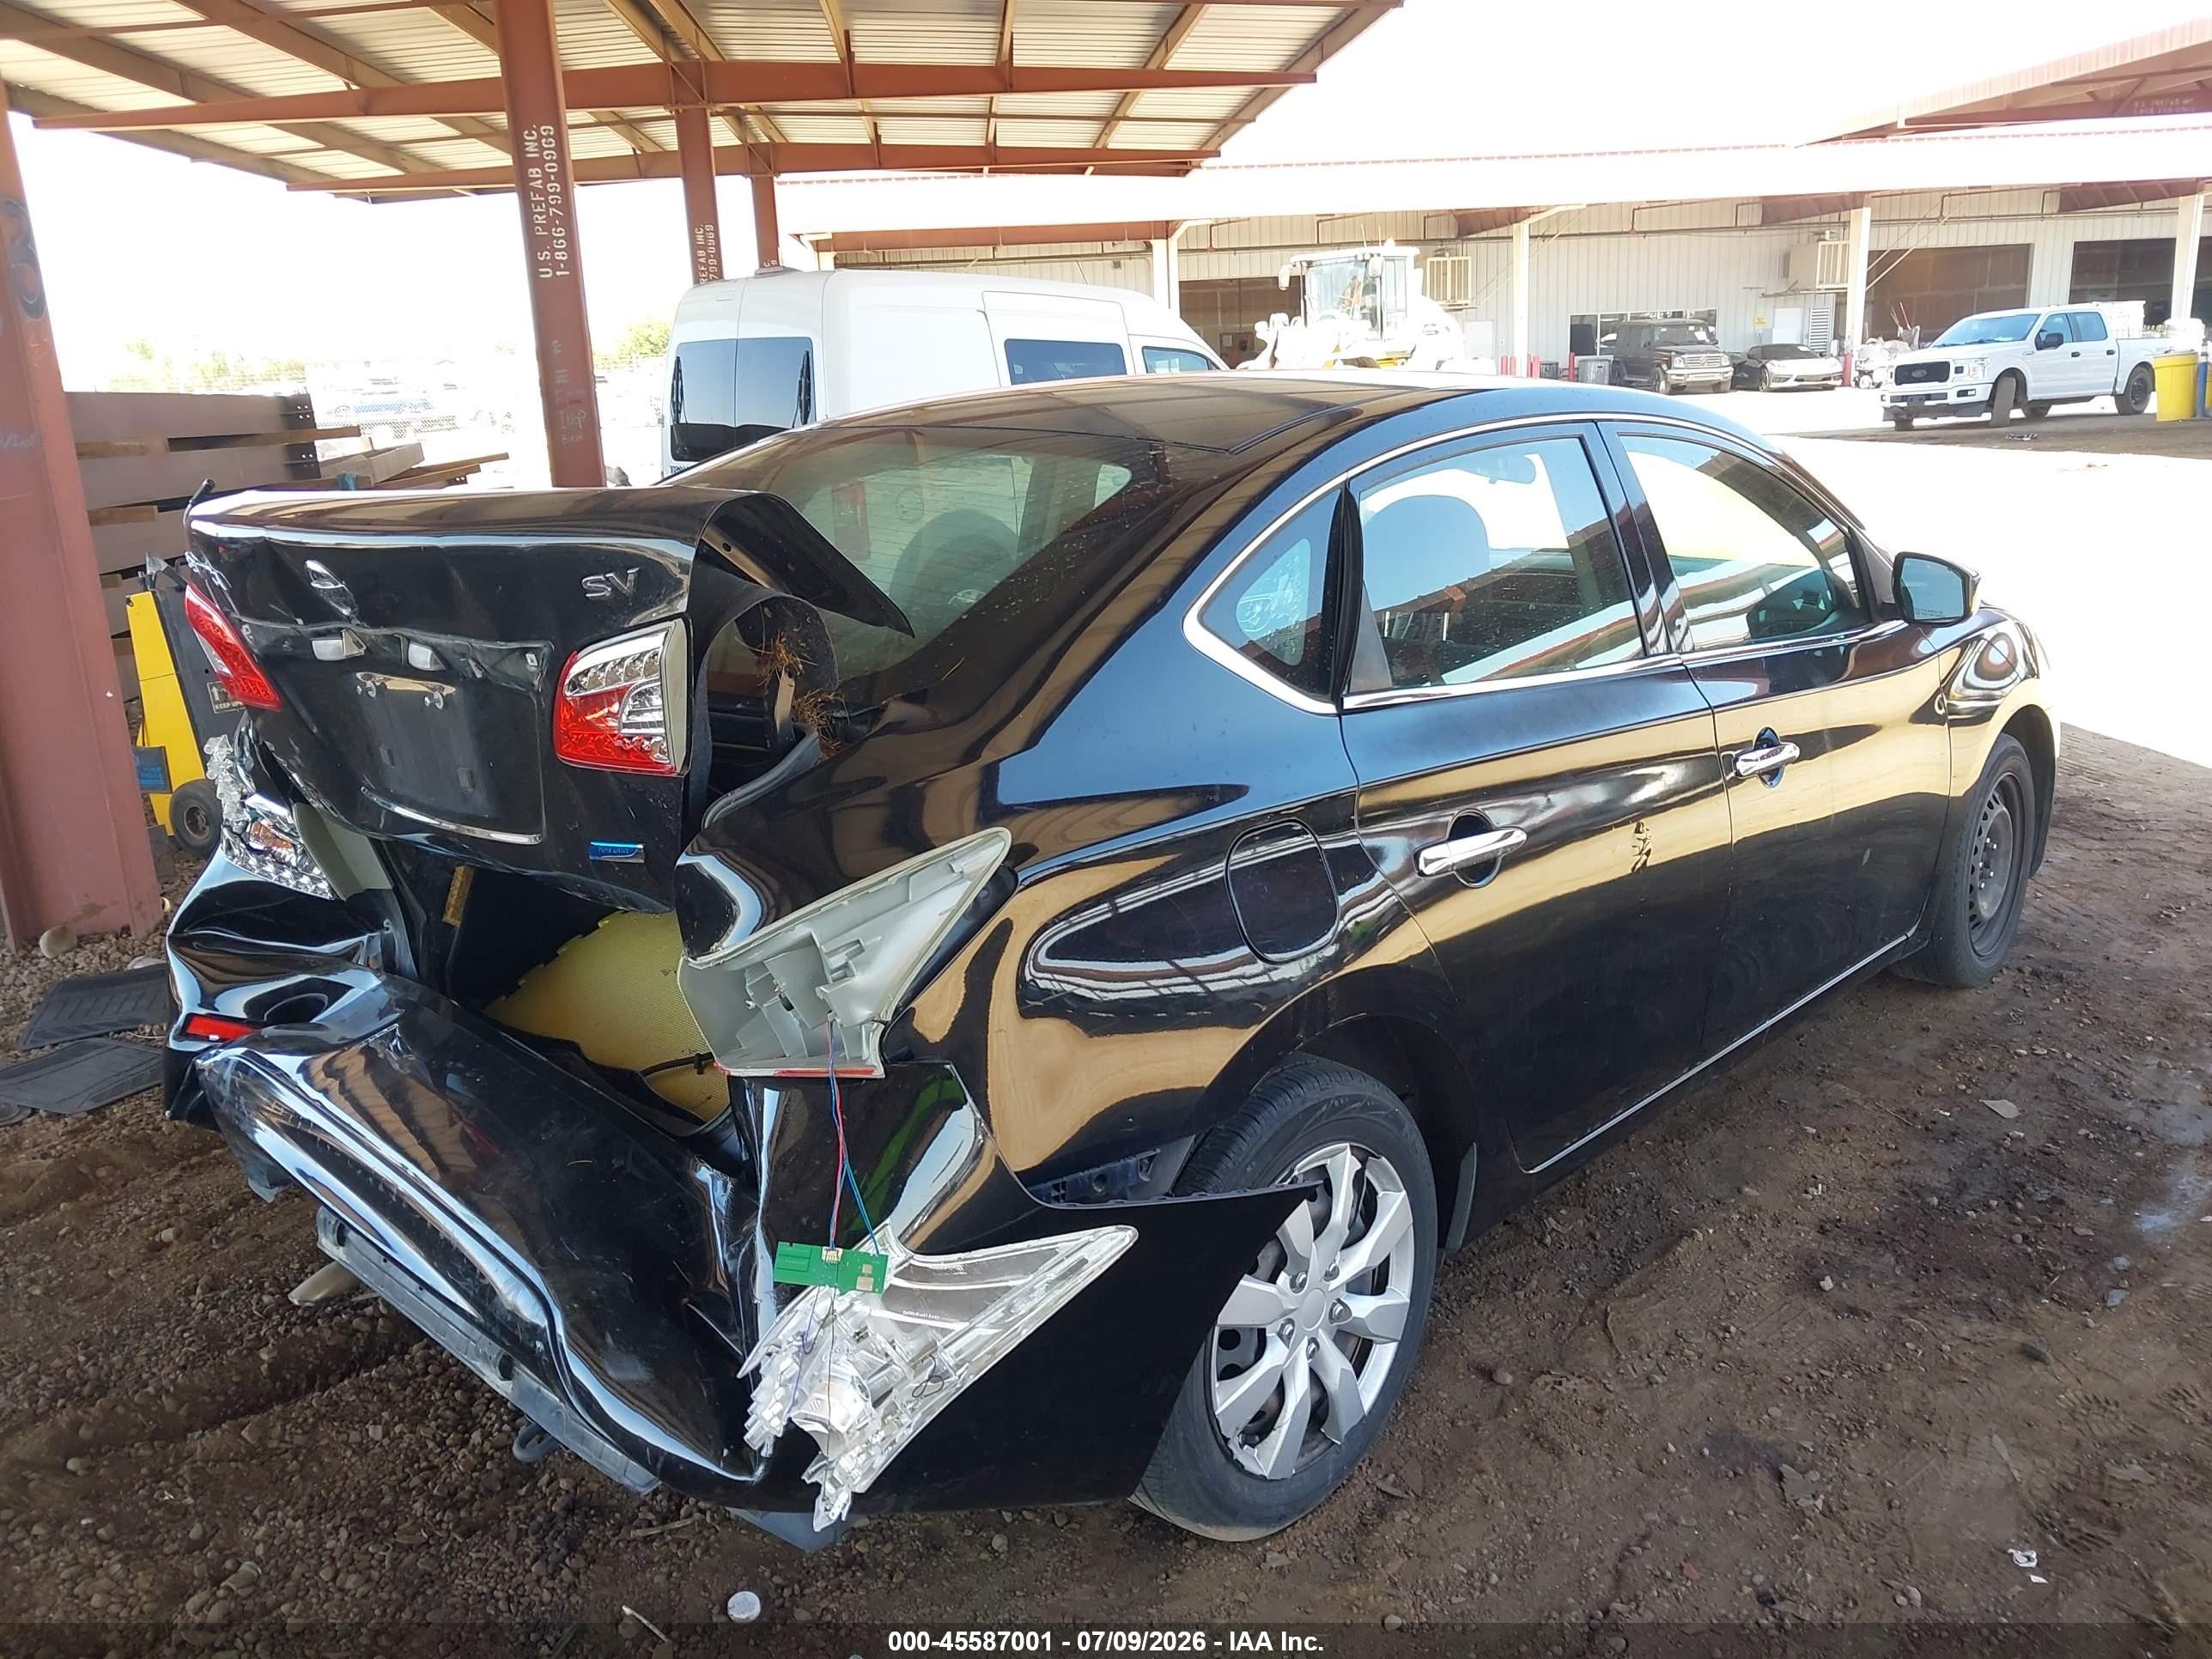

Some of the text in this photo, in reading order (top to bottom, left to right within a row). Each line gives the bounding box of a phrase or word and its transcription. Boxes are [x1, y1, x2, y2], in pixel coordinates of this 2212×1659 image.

[523, 125, 553, 278] U.S. PREFAB INC.
[540, 125, 570, 276] 1-866-799-0969
[696, 250, 708, 284] REFAB
[582, 567, 640, 599] SV
